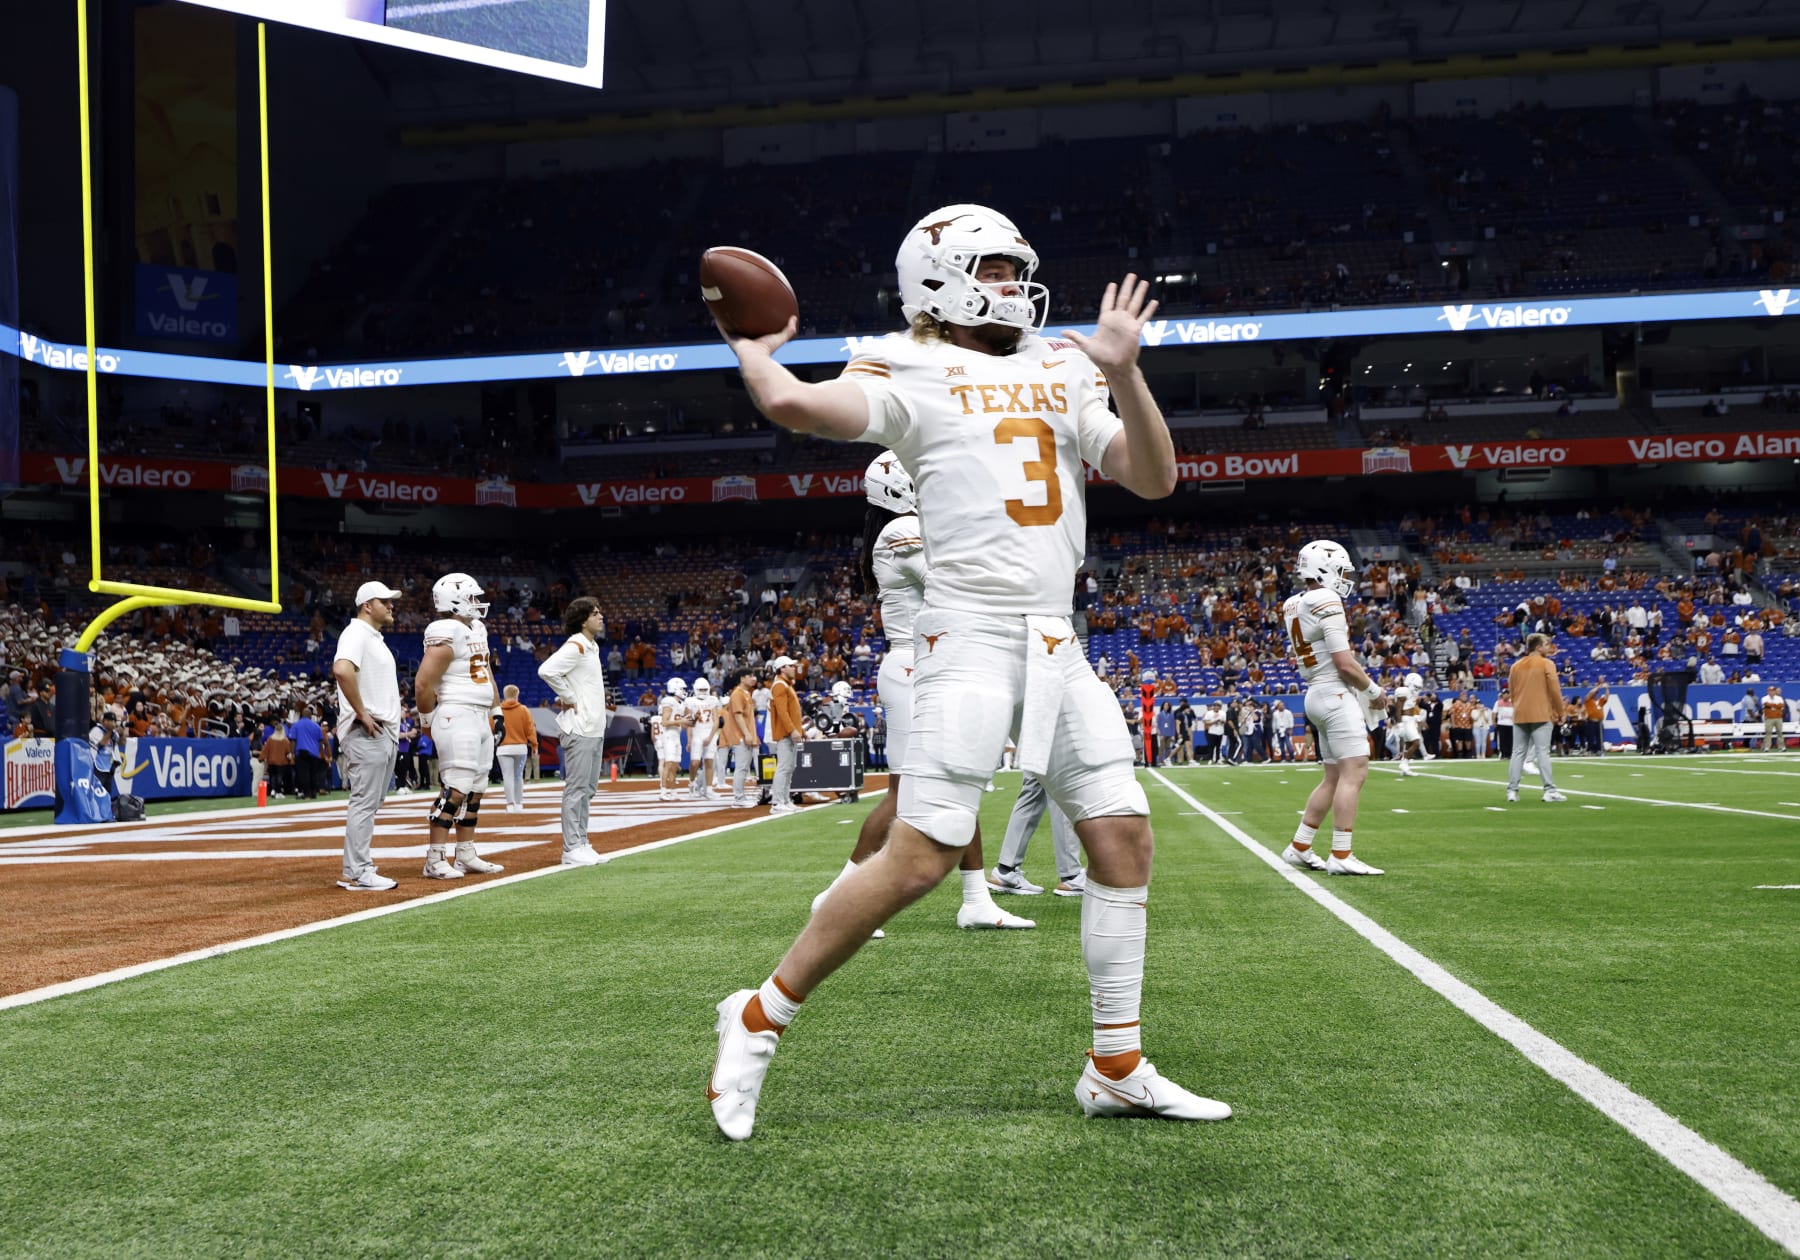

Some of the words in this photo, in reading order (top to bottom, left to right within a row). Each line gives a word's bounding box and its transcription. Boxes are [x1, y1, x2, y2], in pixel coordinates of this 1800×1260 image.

[147, 312, 227, 337] Valero
[1481, 305, 1569, 328] Valero
[1176, 321, 1260, 343] Valero
[598, 352, 676, 373] Valero
[325, 367, 401, 388] Valero
[950, 383, 1069, 415] TEXAS
[1483, 445, 1567, 464] Valero
[1628, 438, 1726, 460] Valero
[98, 463, 192, 487] Valero
[993, 417, 1064, 527] 3
[1225, 454, 1298, 475] Bowl
[358, 478, 438, 501] Valero
[610, 484, 686, 503] Valero
[25, 747, 51, 758] Valero
[149, 745, 238, 788] Valero
